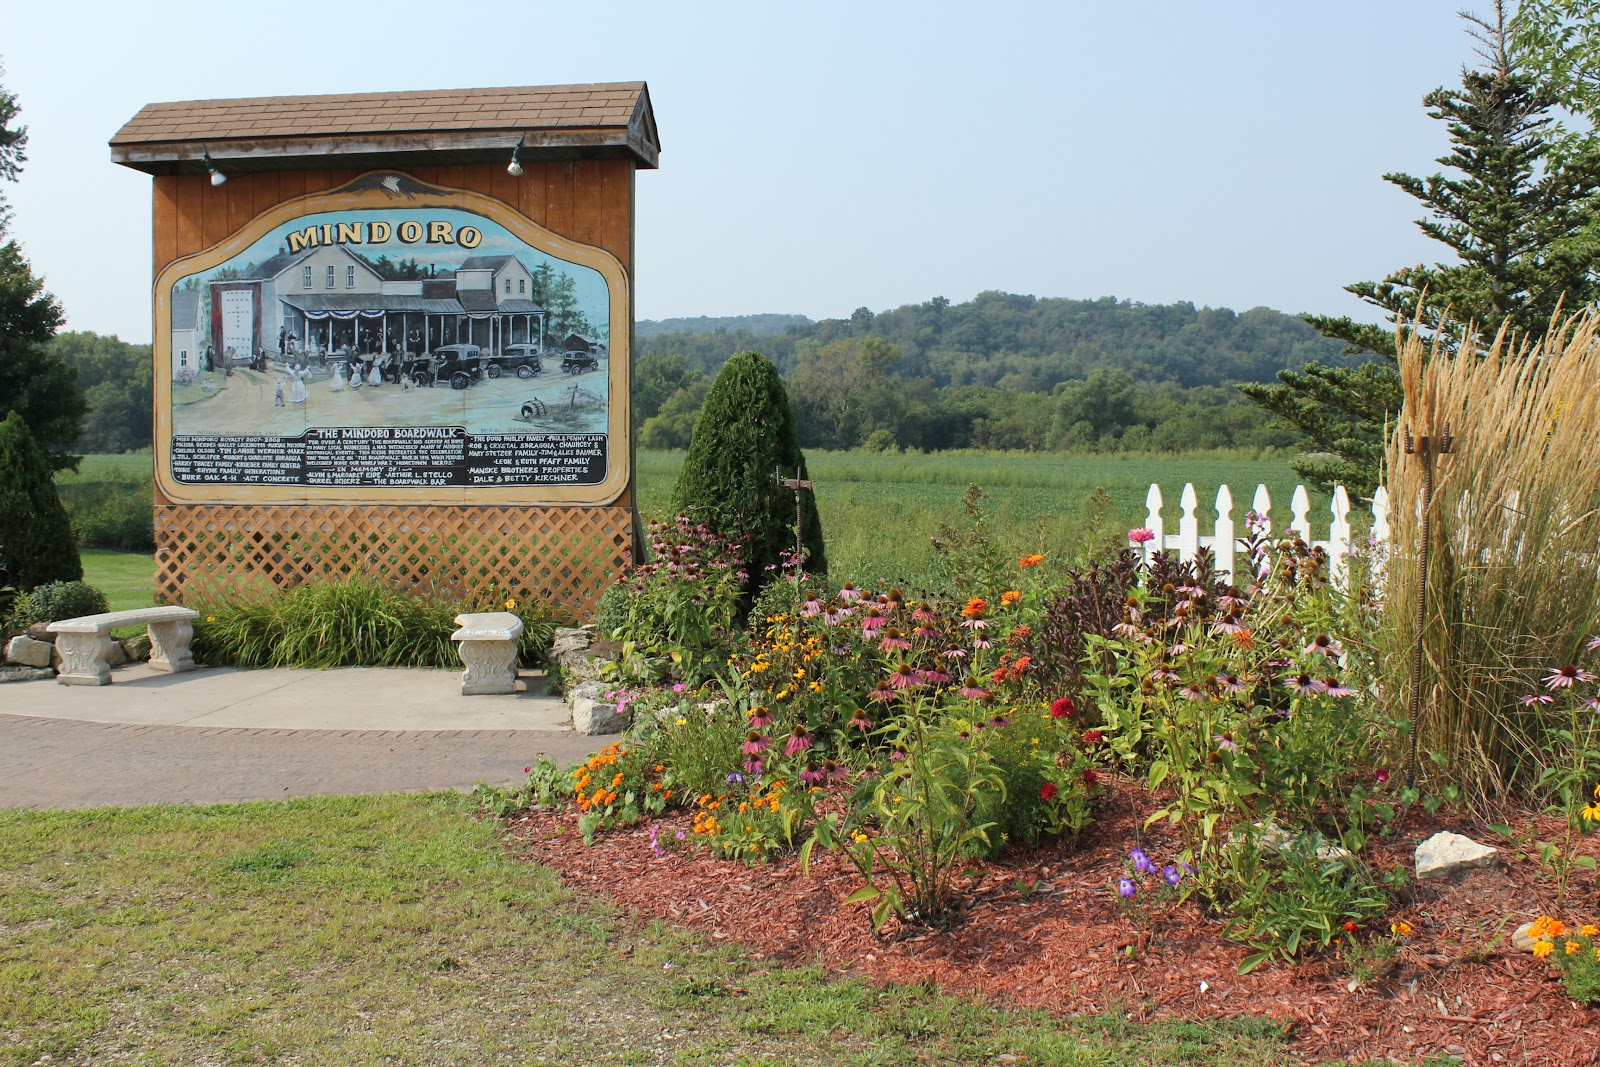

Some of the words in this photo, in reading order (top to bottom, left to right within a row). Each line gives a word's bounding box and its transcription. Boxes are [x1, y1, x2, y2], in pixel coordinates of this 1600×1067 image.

[286, 220, 482, 254] MINDORO
[317, 429, 338, 438] THE
[342, 429, 390, 438] MINDORO
[394, 429, 457, 438] BOARDWALK
